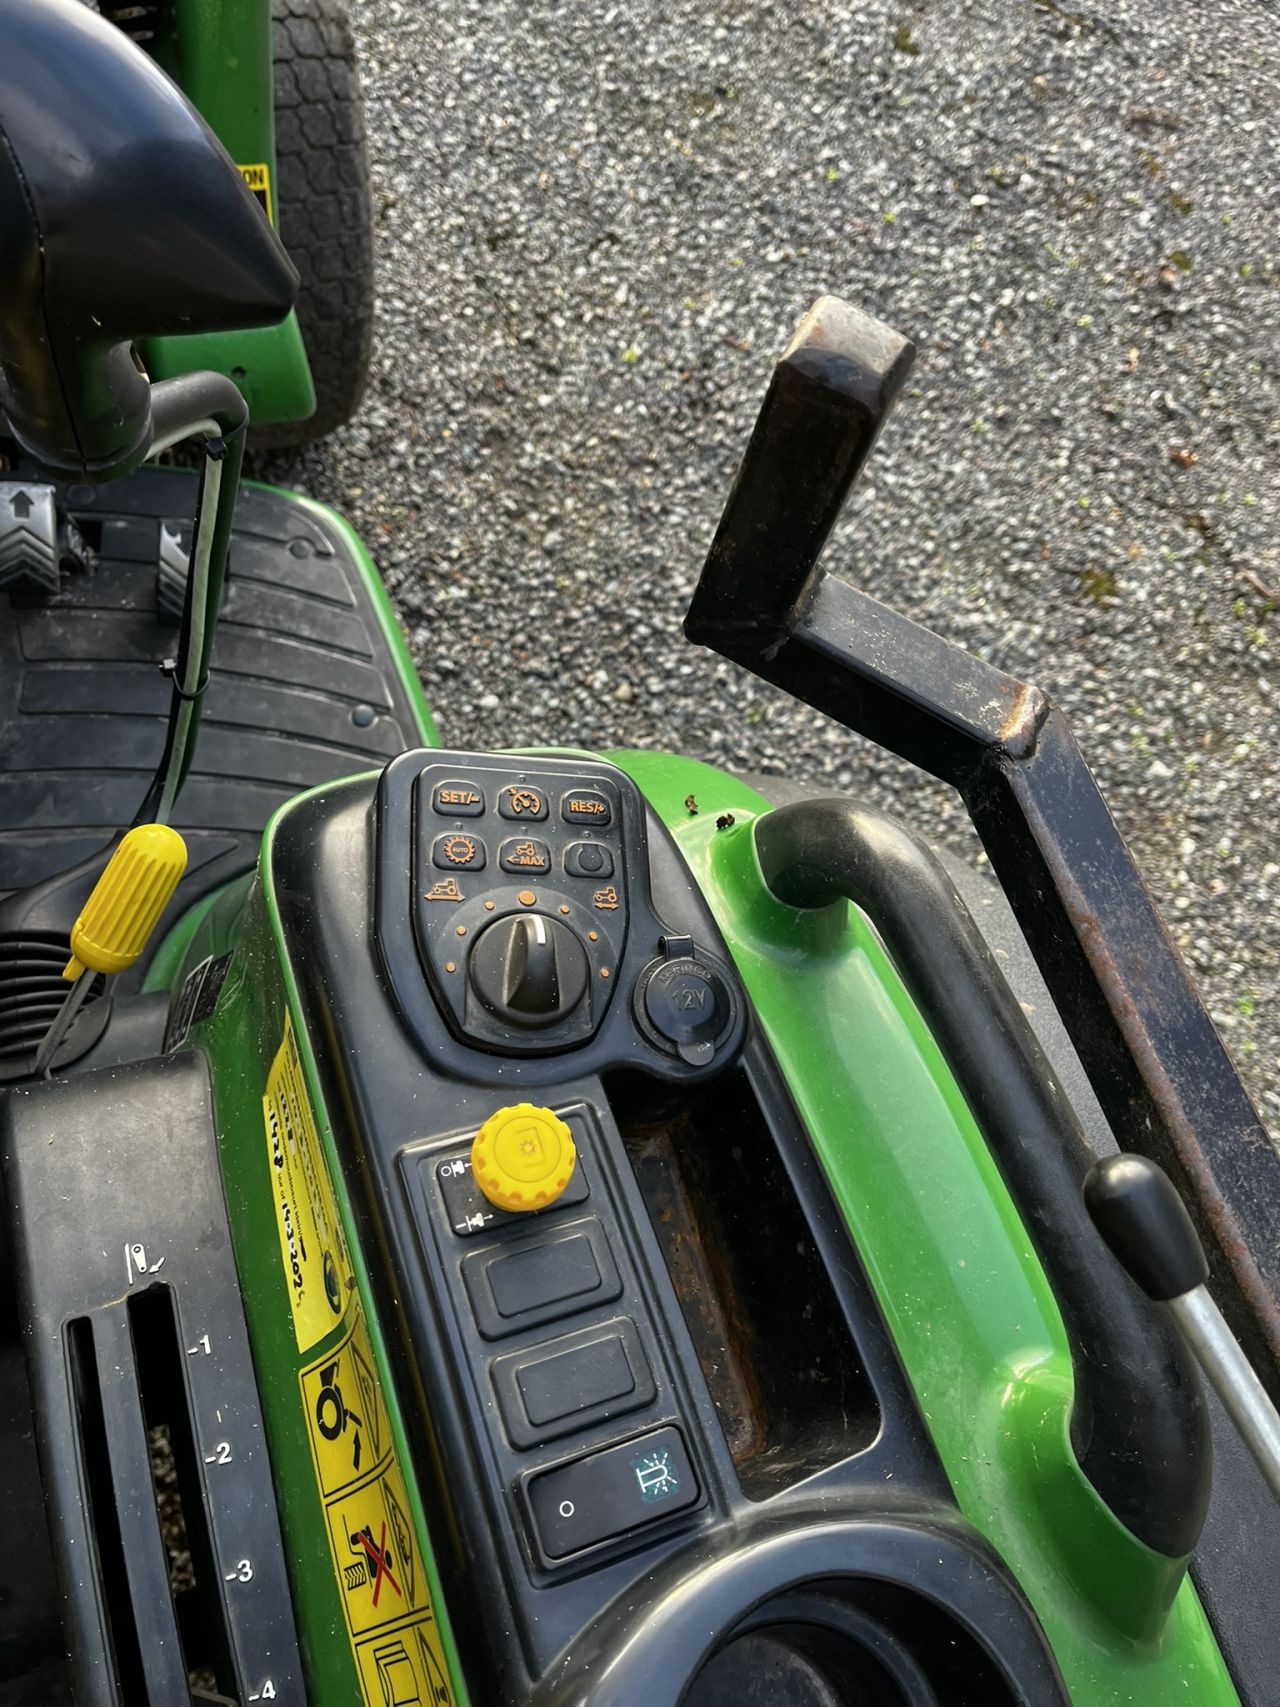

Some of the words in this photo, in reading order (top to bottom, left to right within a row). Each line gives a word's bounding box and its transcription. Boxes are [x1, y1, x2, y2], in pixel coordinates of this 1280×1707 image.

[519, 856, 545, 867] MAX
[672, 988, 706, 1011] 12V
[269, 1112, 284, 1169] 1428
